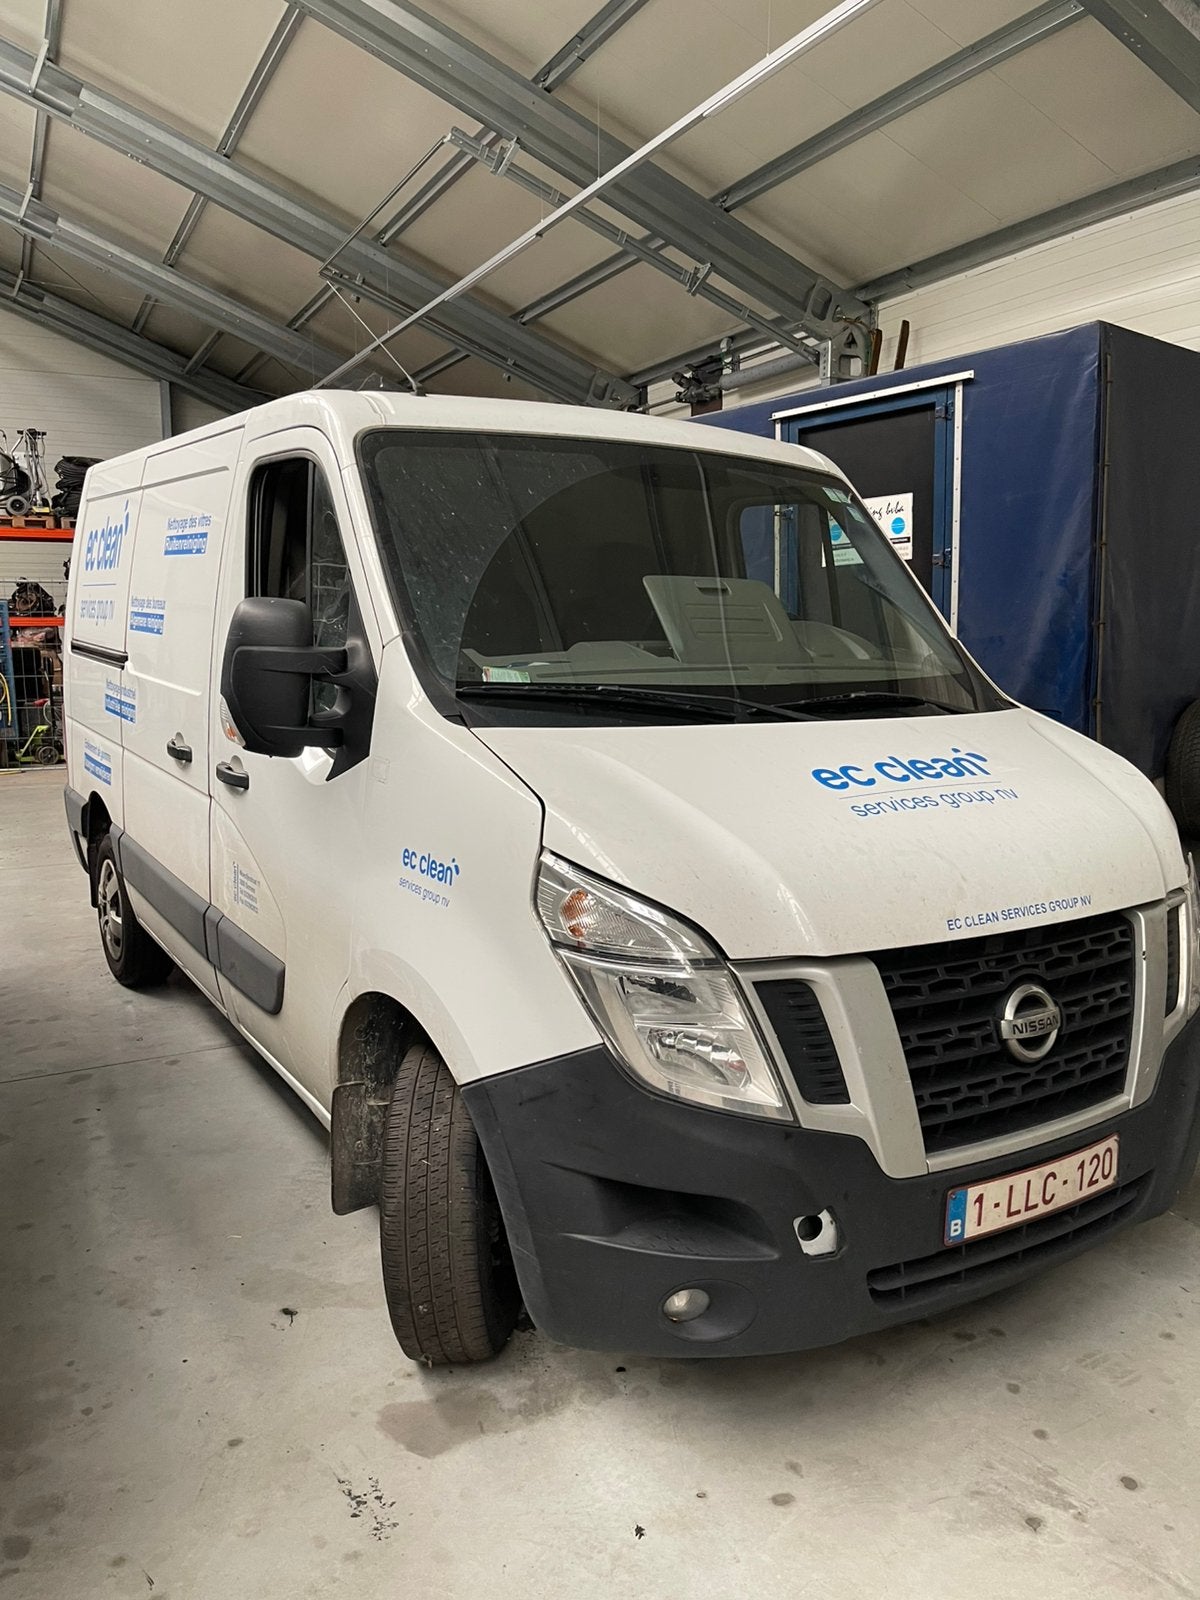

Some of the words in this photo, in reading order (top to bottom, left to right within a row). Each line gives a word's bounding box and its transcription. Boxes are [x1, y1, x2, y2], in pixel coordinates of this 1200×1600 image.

[189, 514, 198, 528] des
[85, 529, 98, 571] ec
[97, 515, 123, 570] clean
[811, 765, 876, 790] ec
[874, 755, 991, 783] clean
[850, 794, 940, 818] services
[939, 789, 996, 809] group
[994, 786, 1019, 800] nv
[402, 847, 418, 870] ec
[419, 852, 453, 887] clean
[399, 877, 422, 896] services
[422, 888, 441, 904] group
[441, 896, 451, 908] nv
[946, 918, 963, 931] EC
[964, 911, 1000, 928] CLEAN
[1000, 902, 1047, 921] SERVICES
[1048, 897, 1079, 912] GROUP
[1080, 895, 1092, 906] NV
[1012, 1014, 1059, 1035] NISSAN
[950, 1219, 962, 1237] B
